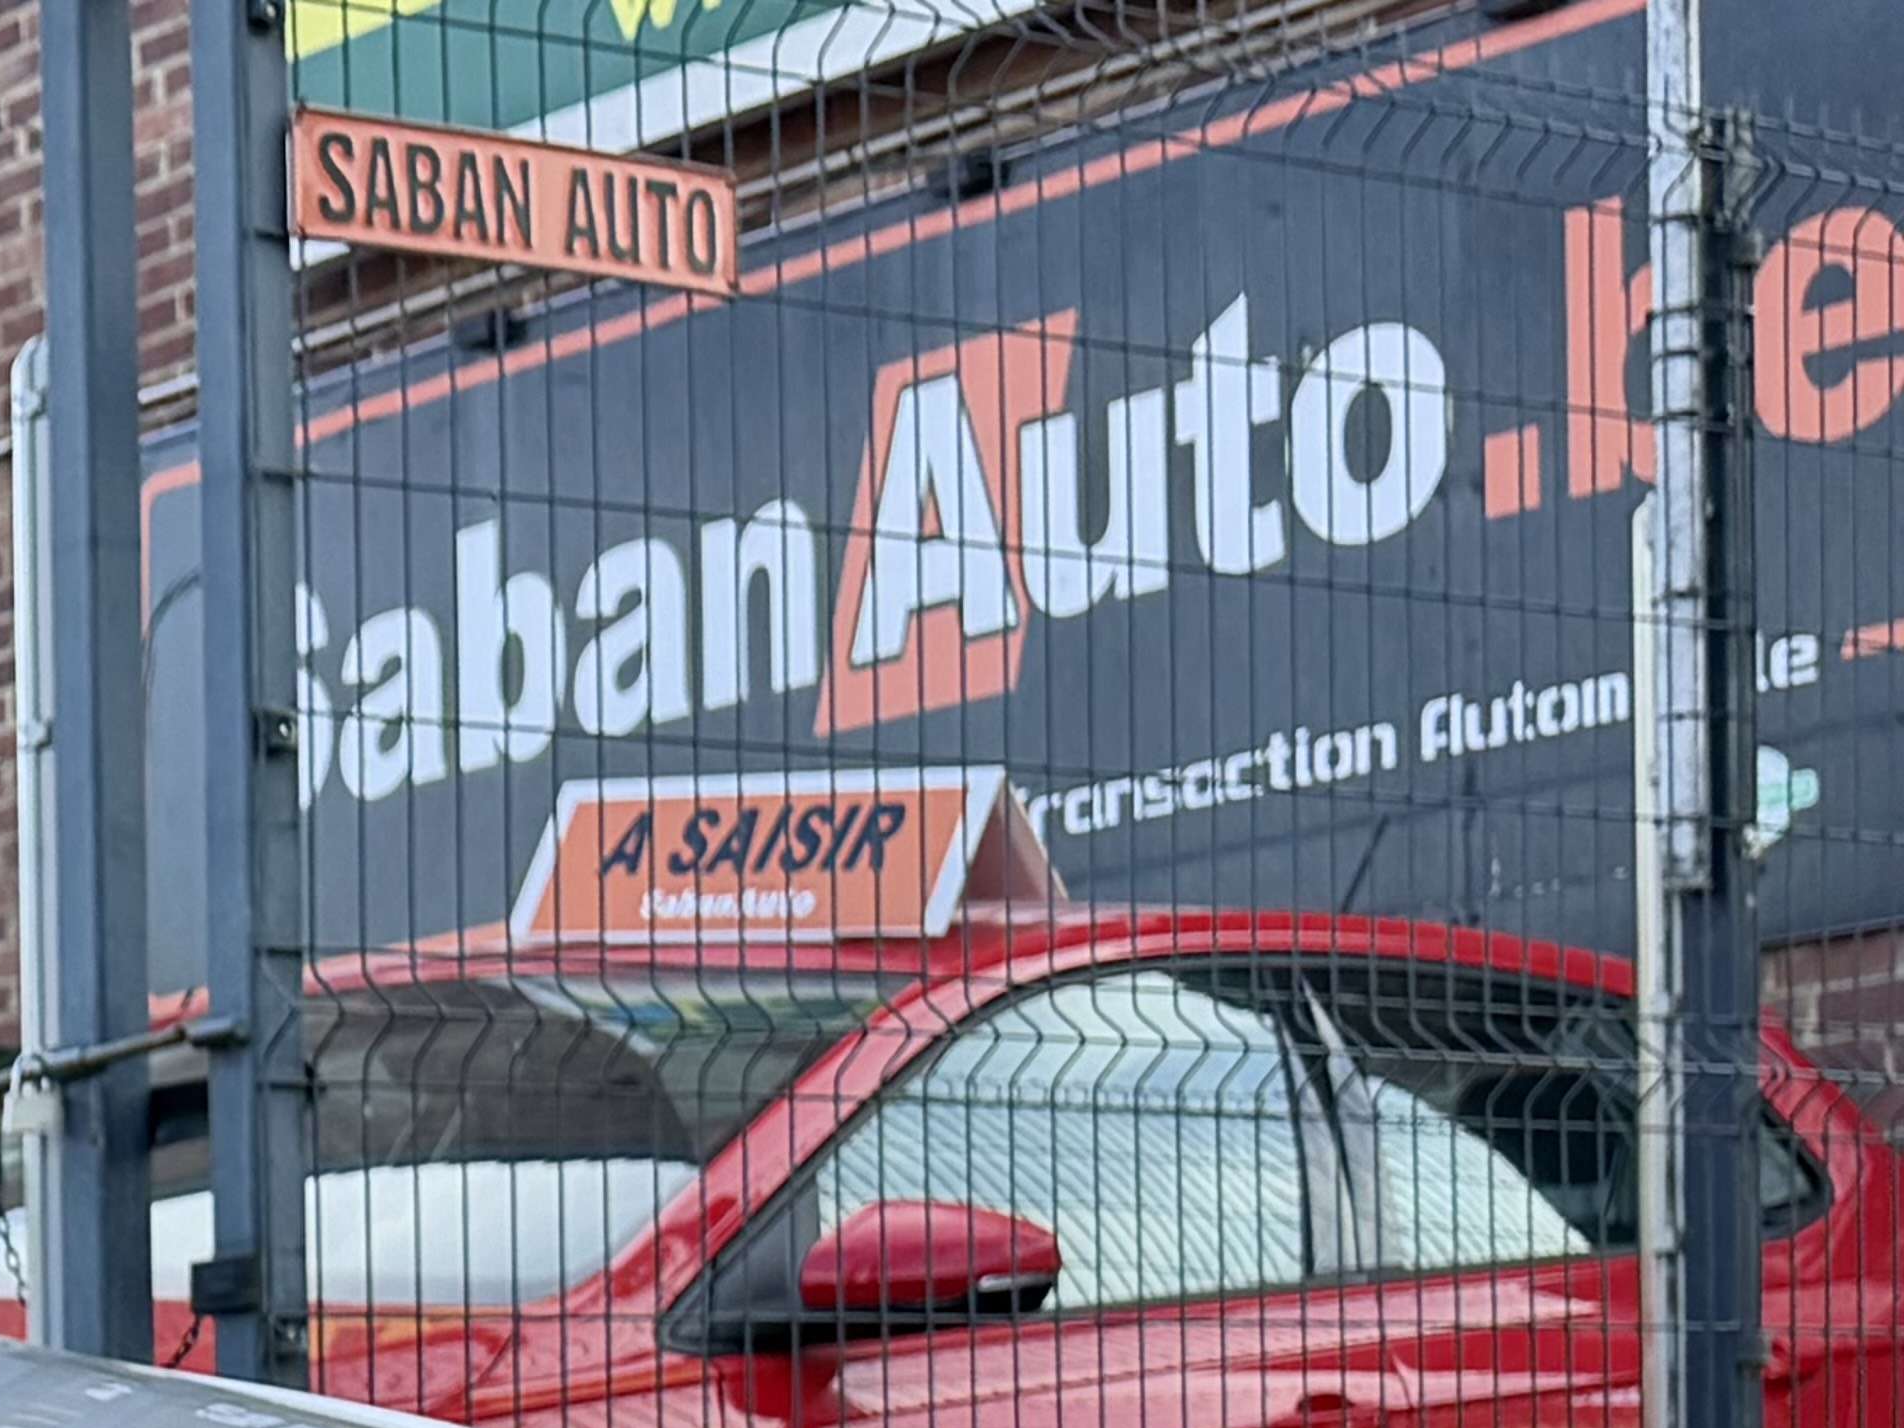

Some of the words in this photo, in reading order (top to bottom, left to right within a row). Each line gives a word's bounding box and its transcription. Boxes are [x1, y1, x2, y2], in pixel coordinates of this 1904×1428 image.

[317, 132, 532, 250] SABAN
[564, 167, 717, 274] AUTO
[1015, 722, 1398, 836] ransaction
[1420, 630, 1820, 762] Automle
[602, 810, 651, 877] A
[668, 803, 906, 875] SAISIR
